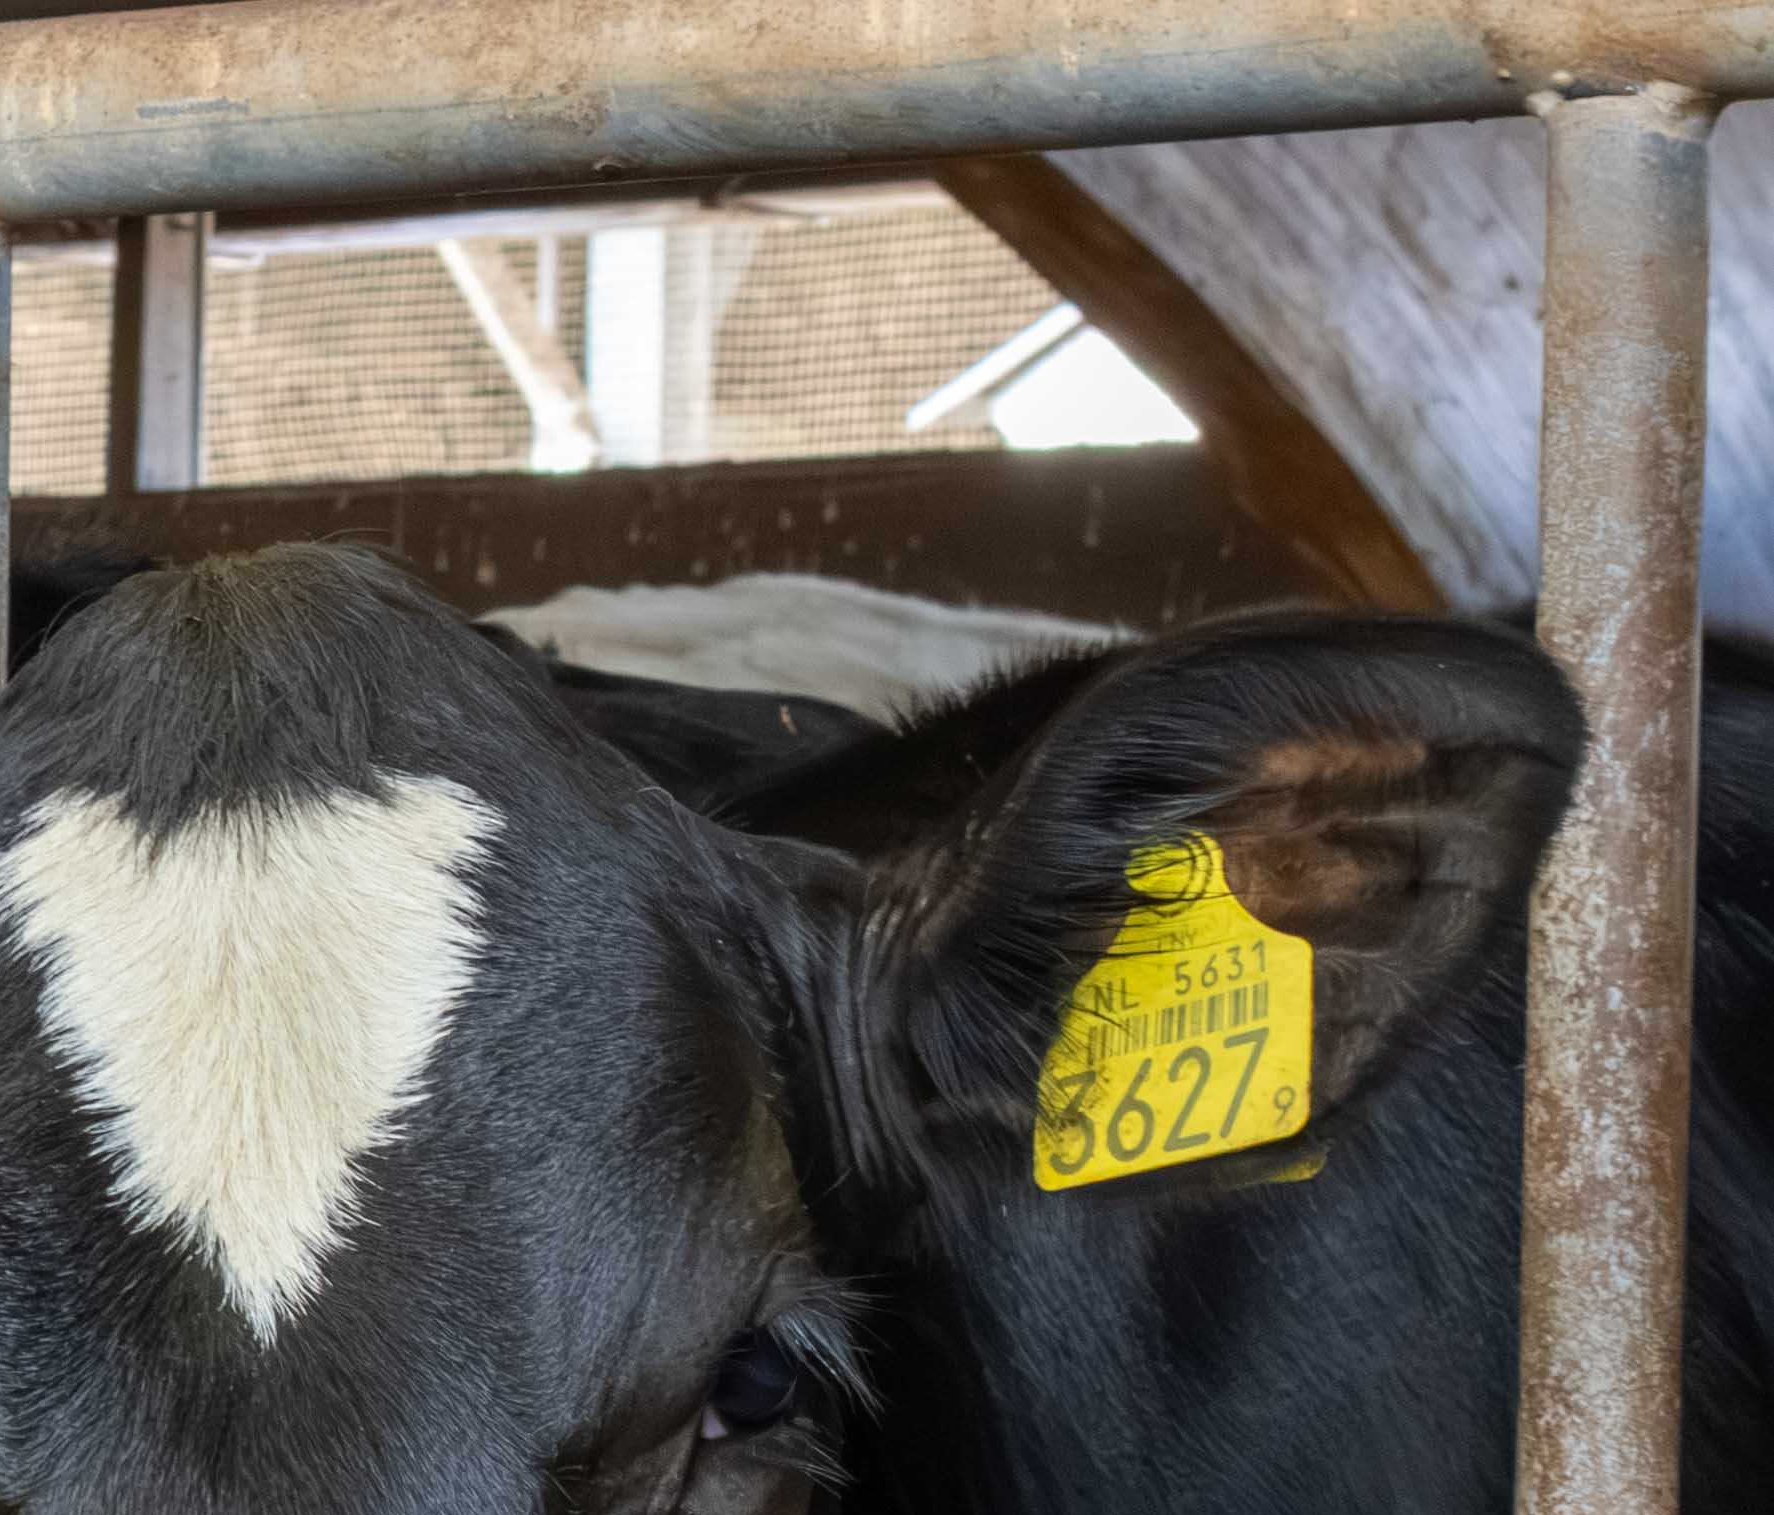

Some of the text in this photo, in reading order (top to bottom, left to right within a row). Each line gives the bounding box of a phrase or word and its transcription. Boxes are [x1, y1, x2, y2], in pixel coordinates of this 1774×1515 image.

[1093, 940, 1267, 1014] NL 5631
[1049, 1027, 1269, 1175] 3627
